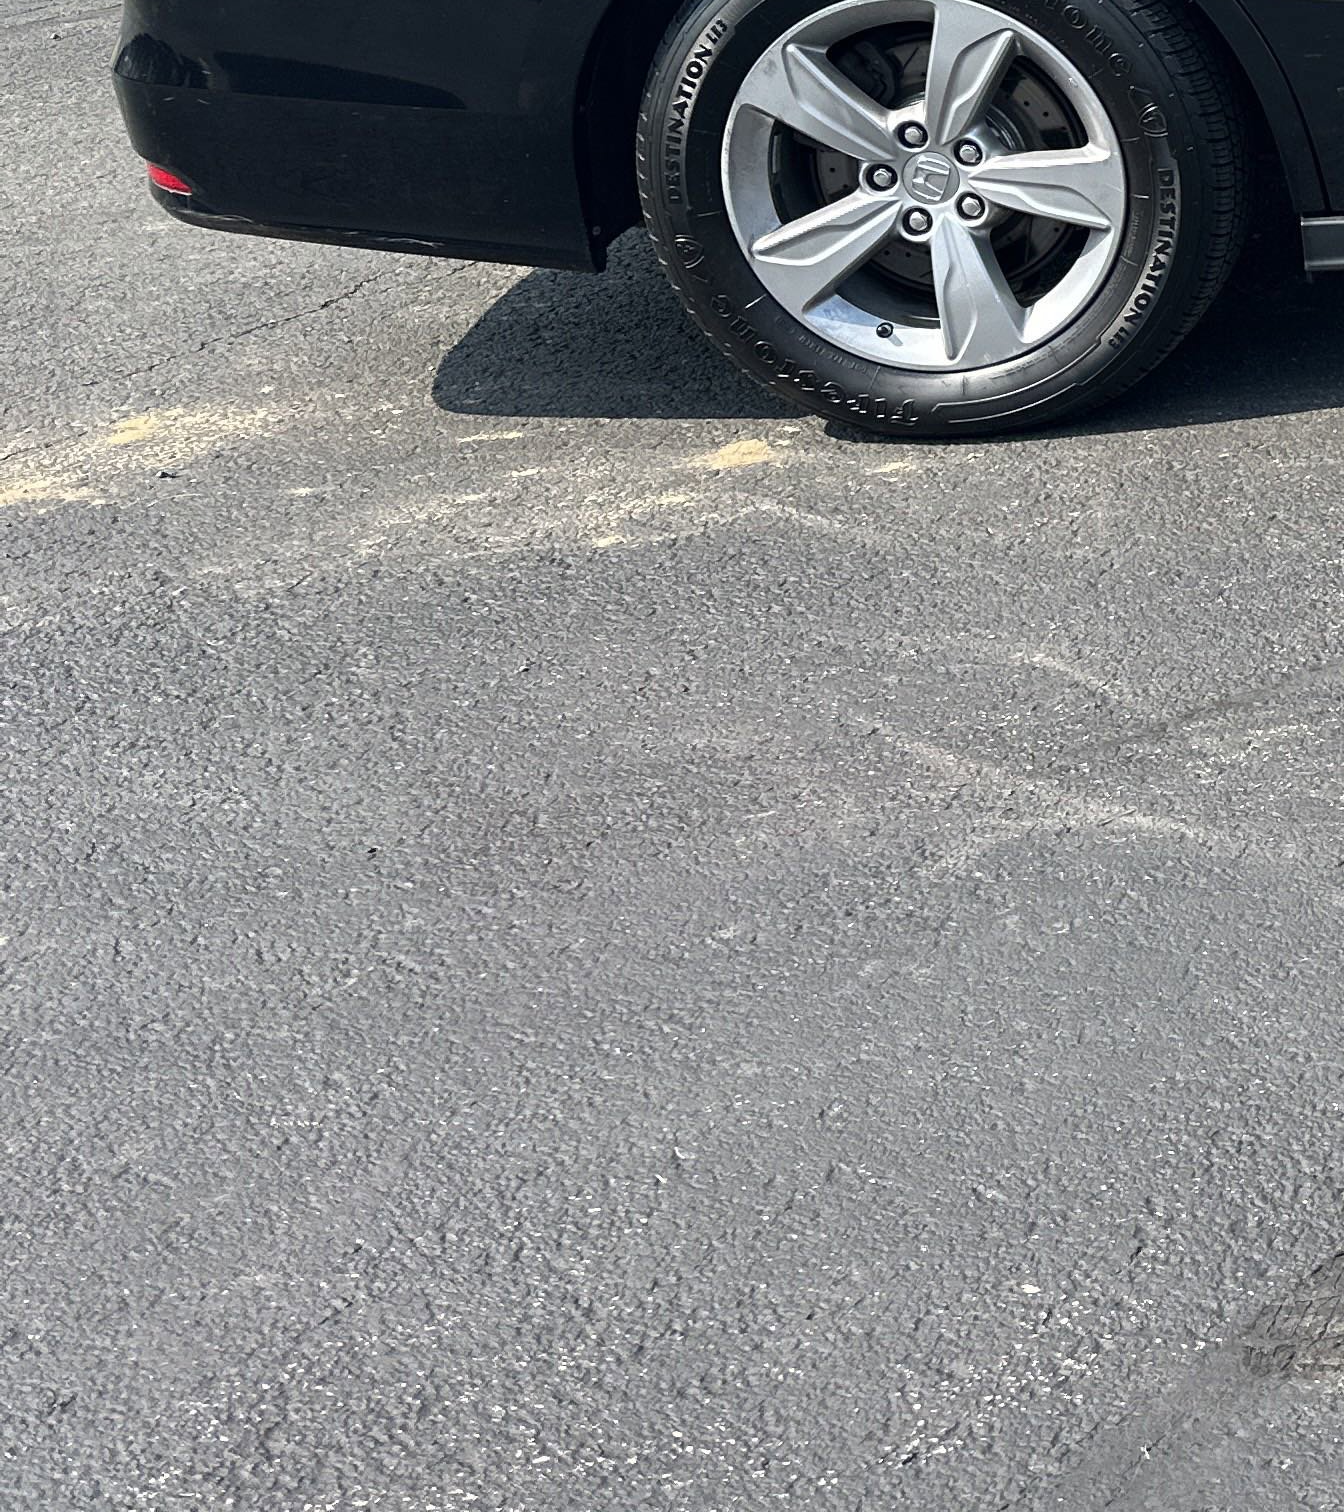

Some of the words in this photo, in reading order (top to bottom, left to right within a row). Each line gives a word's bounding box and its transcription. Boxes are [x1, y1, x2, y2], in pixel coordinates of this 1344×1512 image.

[663, 44, 713, 205] DESTINATION
[705, 18, 729, 45] LE3
[1123, 168, 1177, 324] DESTINATION
